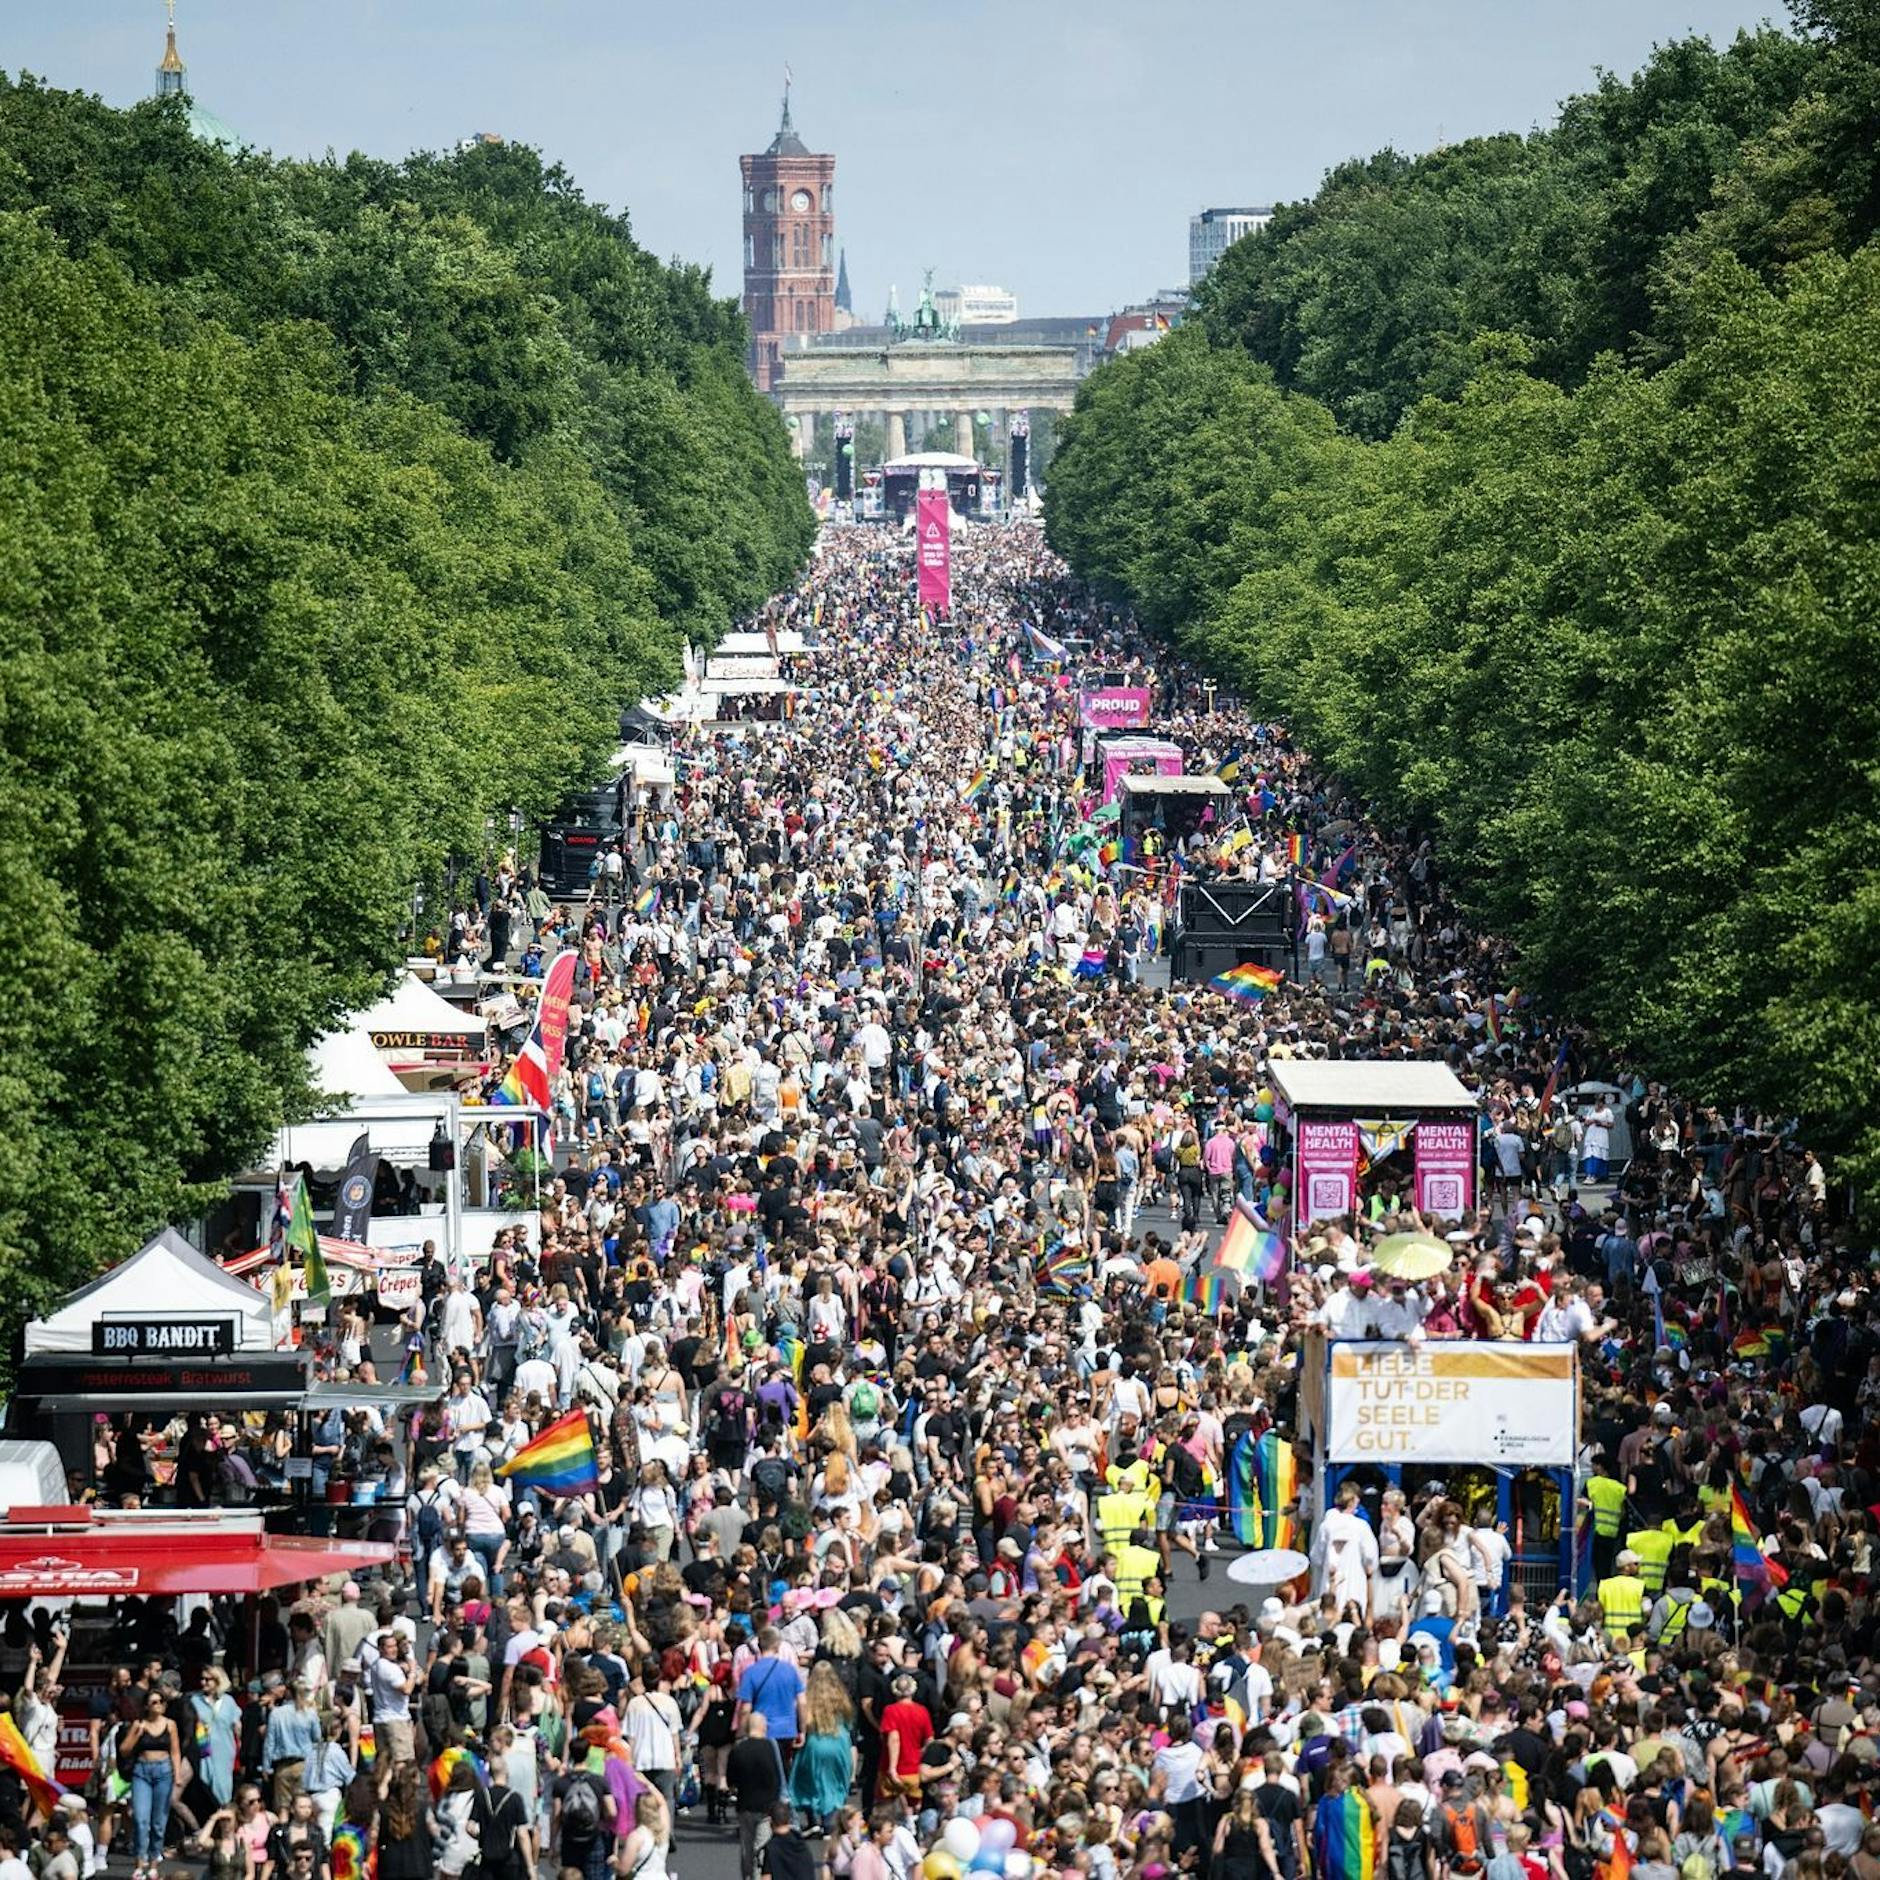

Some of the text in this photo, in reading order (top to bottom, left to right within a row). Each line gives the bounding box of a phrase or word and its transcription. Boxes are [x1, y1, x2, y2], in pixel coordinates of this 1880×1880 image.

[1092, 699, 1140, 712] PROUD
[541, 1022, 561, 1037] FASS
[373, 1033, 468, 1048] OWLE BAR
[1305, 1125, 1356, 1137] MENTAL
[1418, 1125, 1469, 1137] MENTAL
[1305, 1138, 1353, 1149] HEALTH
[1418, 1138, 1467, 1149] HEALTH
[103, 1327, 140, 1349] BBQ
[1356, 1353, 1434, 1377] LIEBE
[181, 1370, 252, 1385] Bratwurst
[1357, 1380, 1470, 1400] TUT DER
[1358, 1405, 1440, 1425] SEELE
[1356, 1430, 1416, 1450] GUT.
